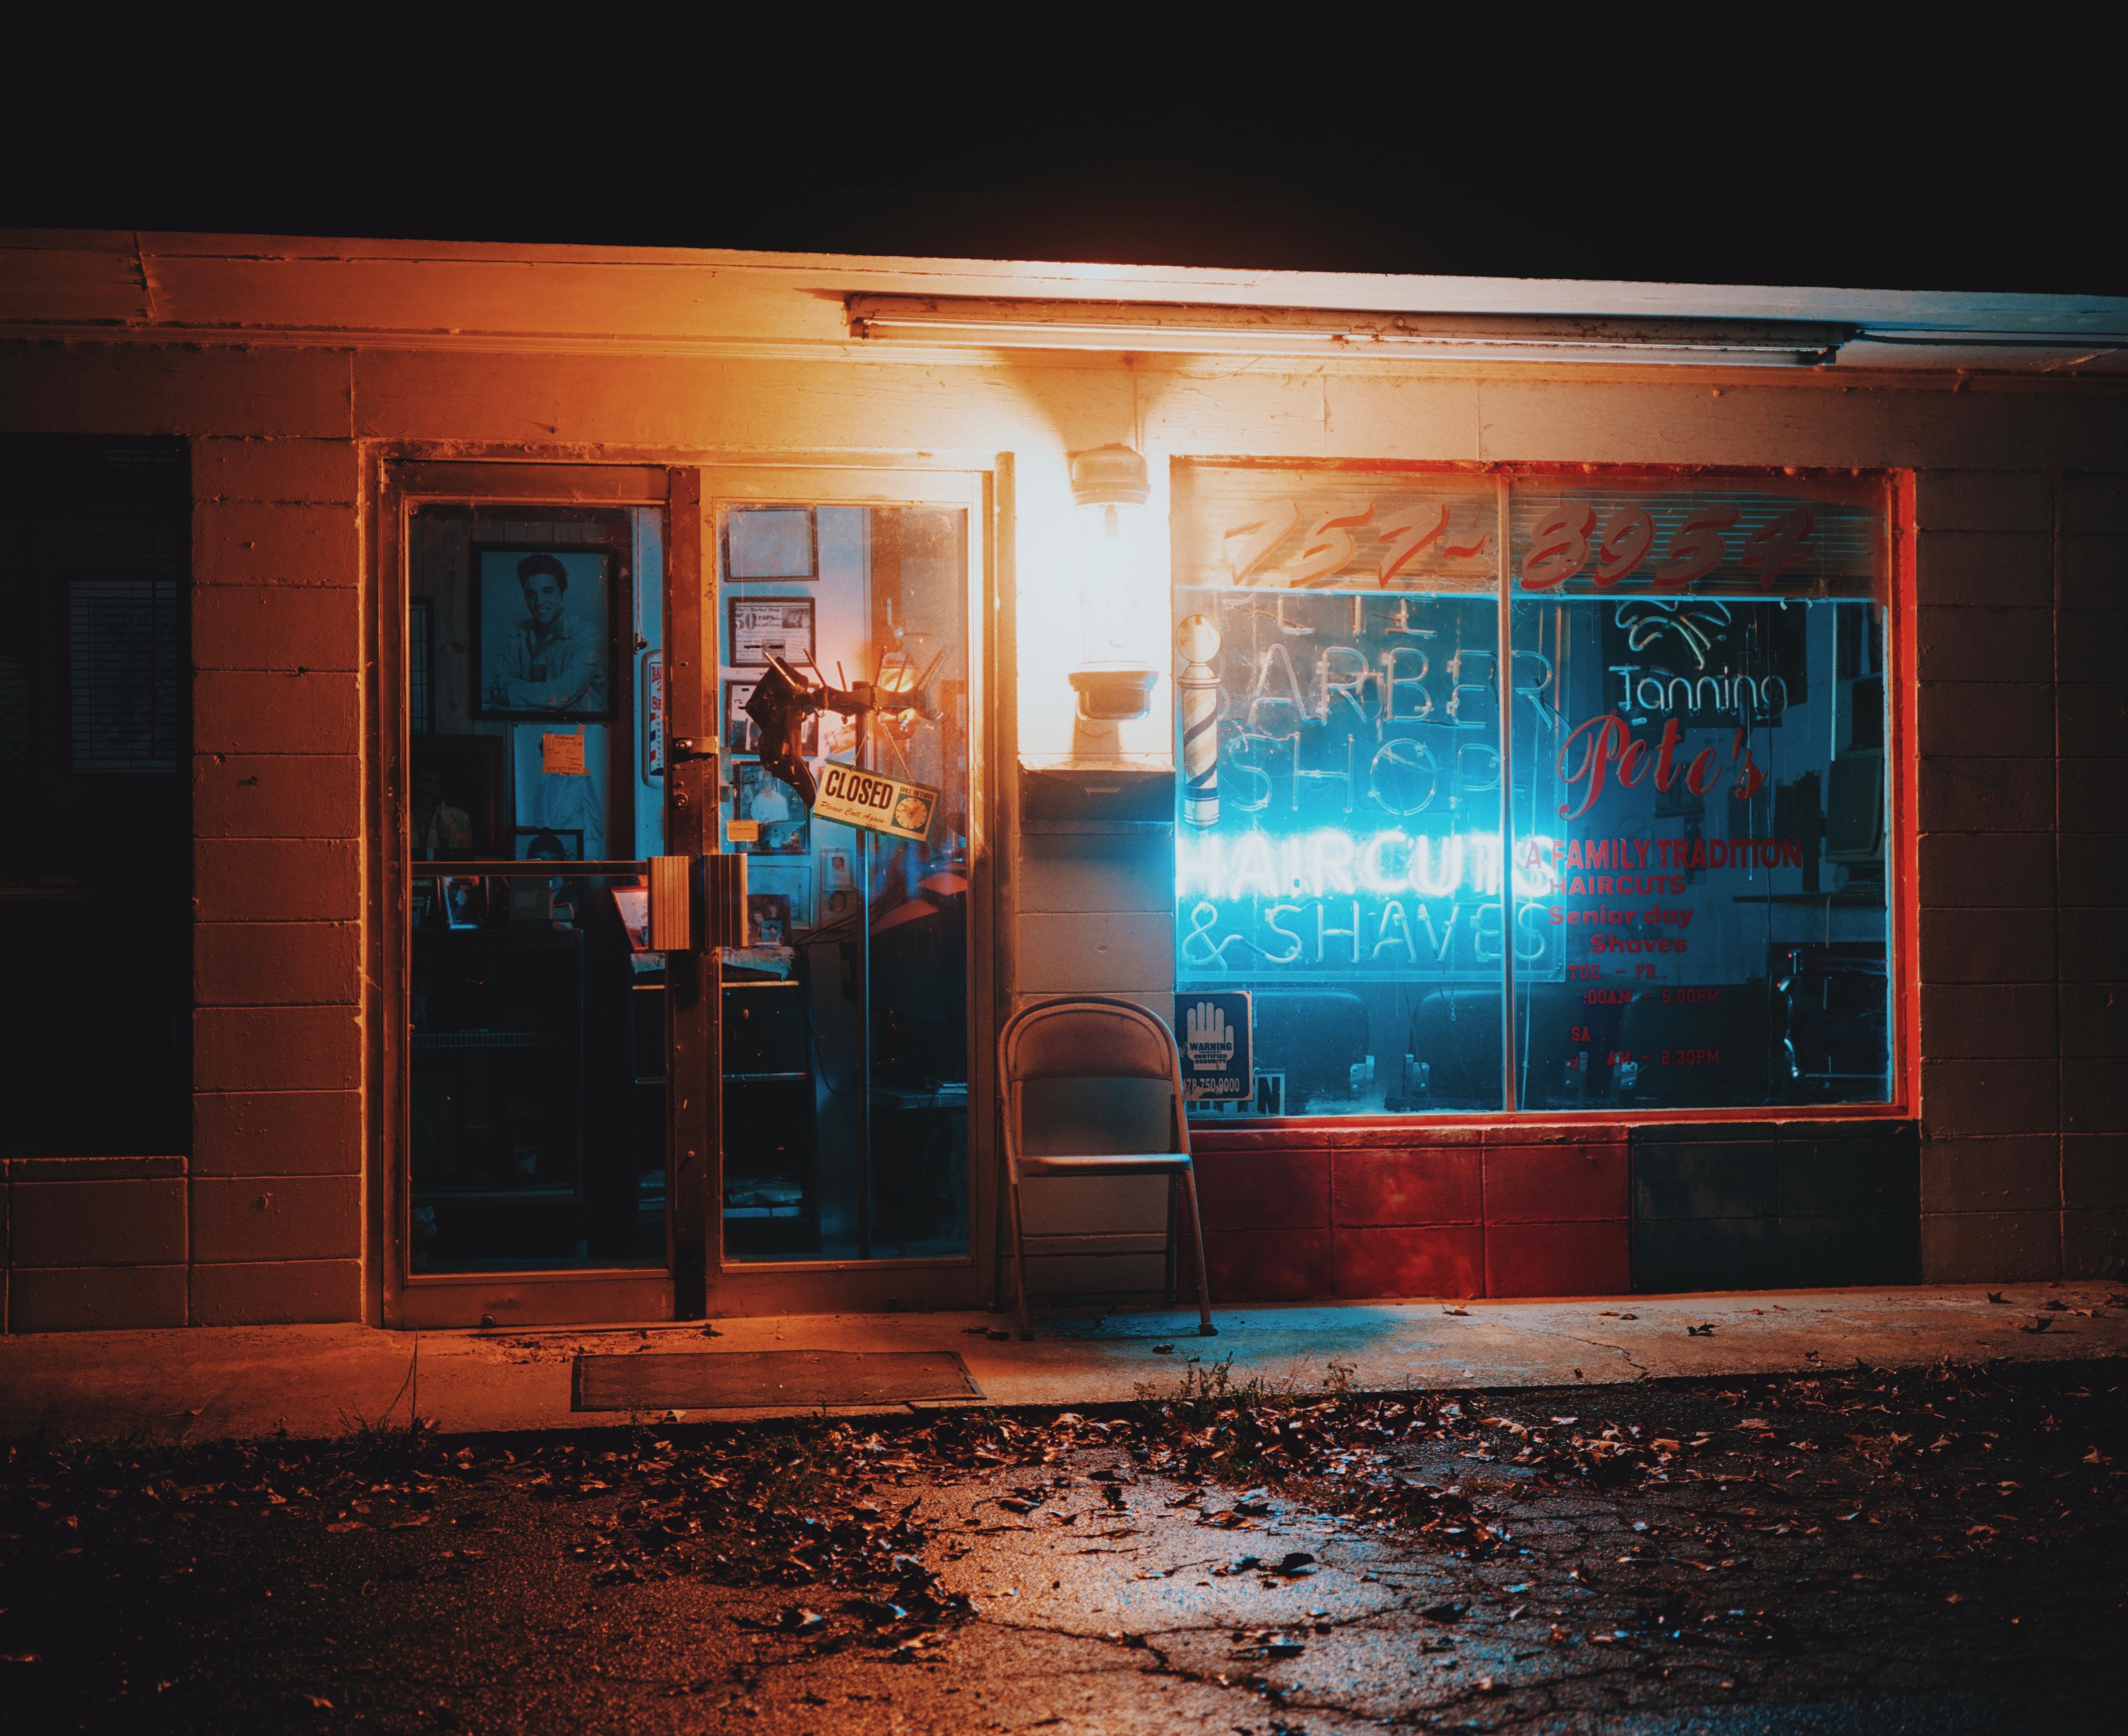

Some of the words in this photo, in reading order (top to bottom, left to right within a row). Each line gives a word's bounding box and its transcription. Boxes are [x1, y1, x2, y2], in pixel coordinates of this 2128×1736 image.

[1609, 664, 1787, 719] Tanning
[1226, 733, 1504, 819] SHOP
[1557, 709, 1767, 820] Pete's
[825, 770, 894, 809] CLOSED
[900, 786, 911, 795] WILL
[913, 790, 933, 800] RETURN
[820, 801, 842, 812] Please
[844, 808, 860, 818] Call
[862, 813, 884, 824] Again
[1177, 831, 1555, 898] HAIRCUTS
[1525, 840, 1542, 869] A
[1551, 839, 1651, 869] FAMILY
[1656, 838, 1802, 869] TRADITION
[1550, 875, 1685, 895] HAIRCUTS
[1548, 905, 1637, 925] Senior
[1644, 904, 1694, 929] day
[1266, 901, 1546, 964] SHAVES
[1590, 933, 1688, 953] Shaves
[1568, 964, 1605, 980] TUE.
[1661, 988, 1720, 1004] 5:00PM
[1189, 1042, 1232, 1051] WARNING
[1661, 1050, 1720, 1065] 2:30PM
